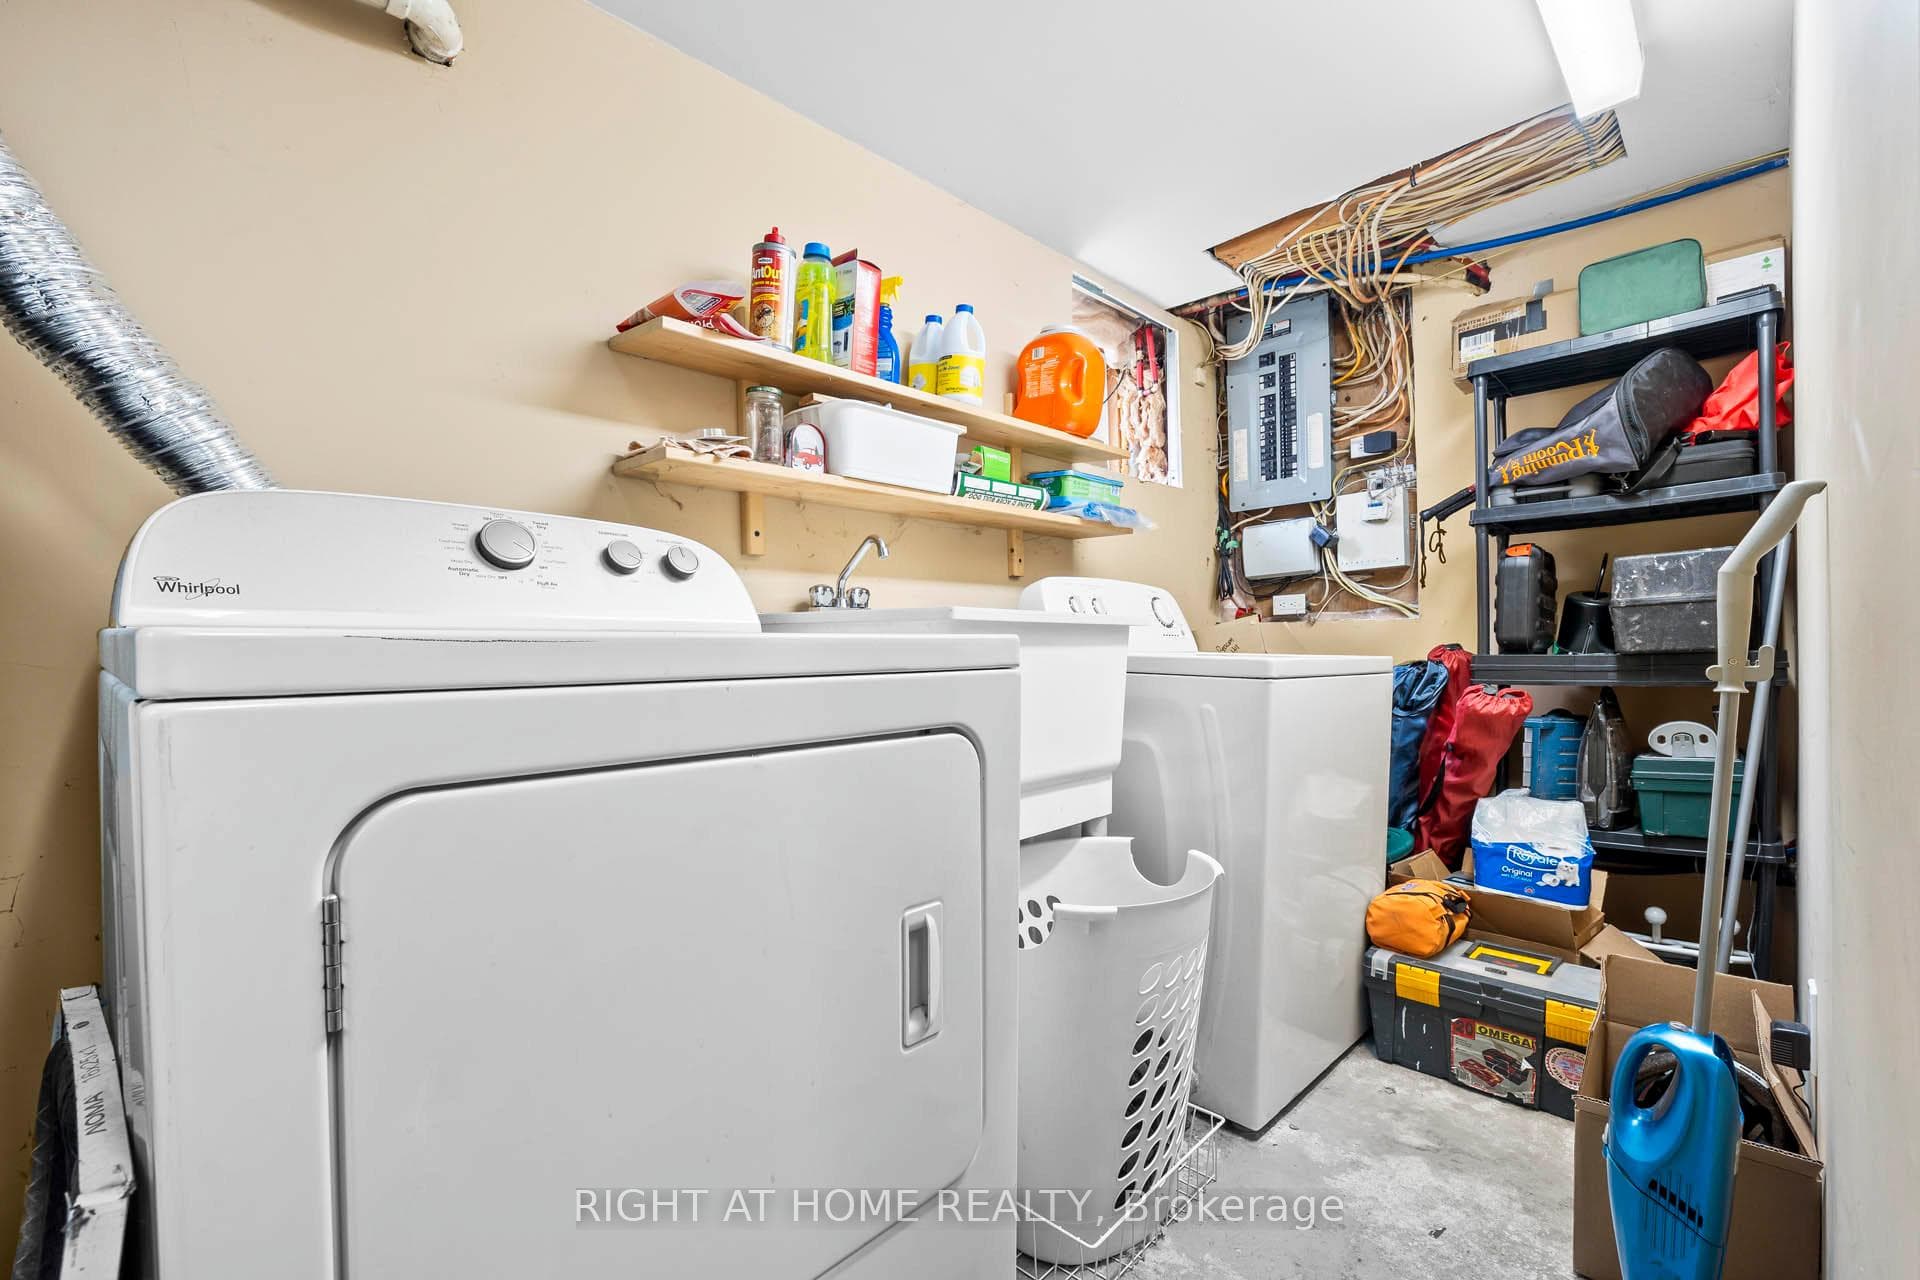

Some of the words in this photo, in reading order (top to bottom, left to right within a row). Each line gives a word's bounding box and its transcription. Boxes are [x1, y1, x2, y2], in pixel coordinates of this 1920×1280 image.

[1511, 437, 1586, 481] Running
[156, 580, 240, 597] Whirlpool
[1501, 865, 1533, 878] Original
[1477, 1025, 1533, 1049] OMEGA
[84, 1090, 107, 1137] NOMA
